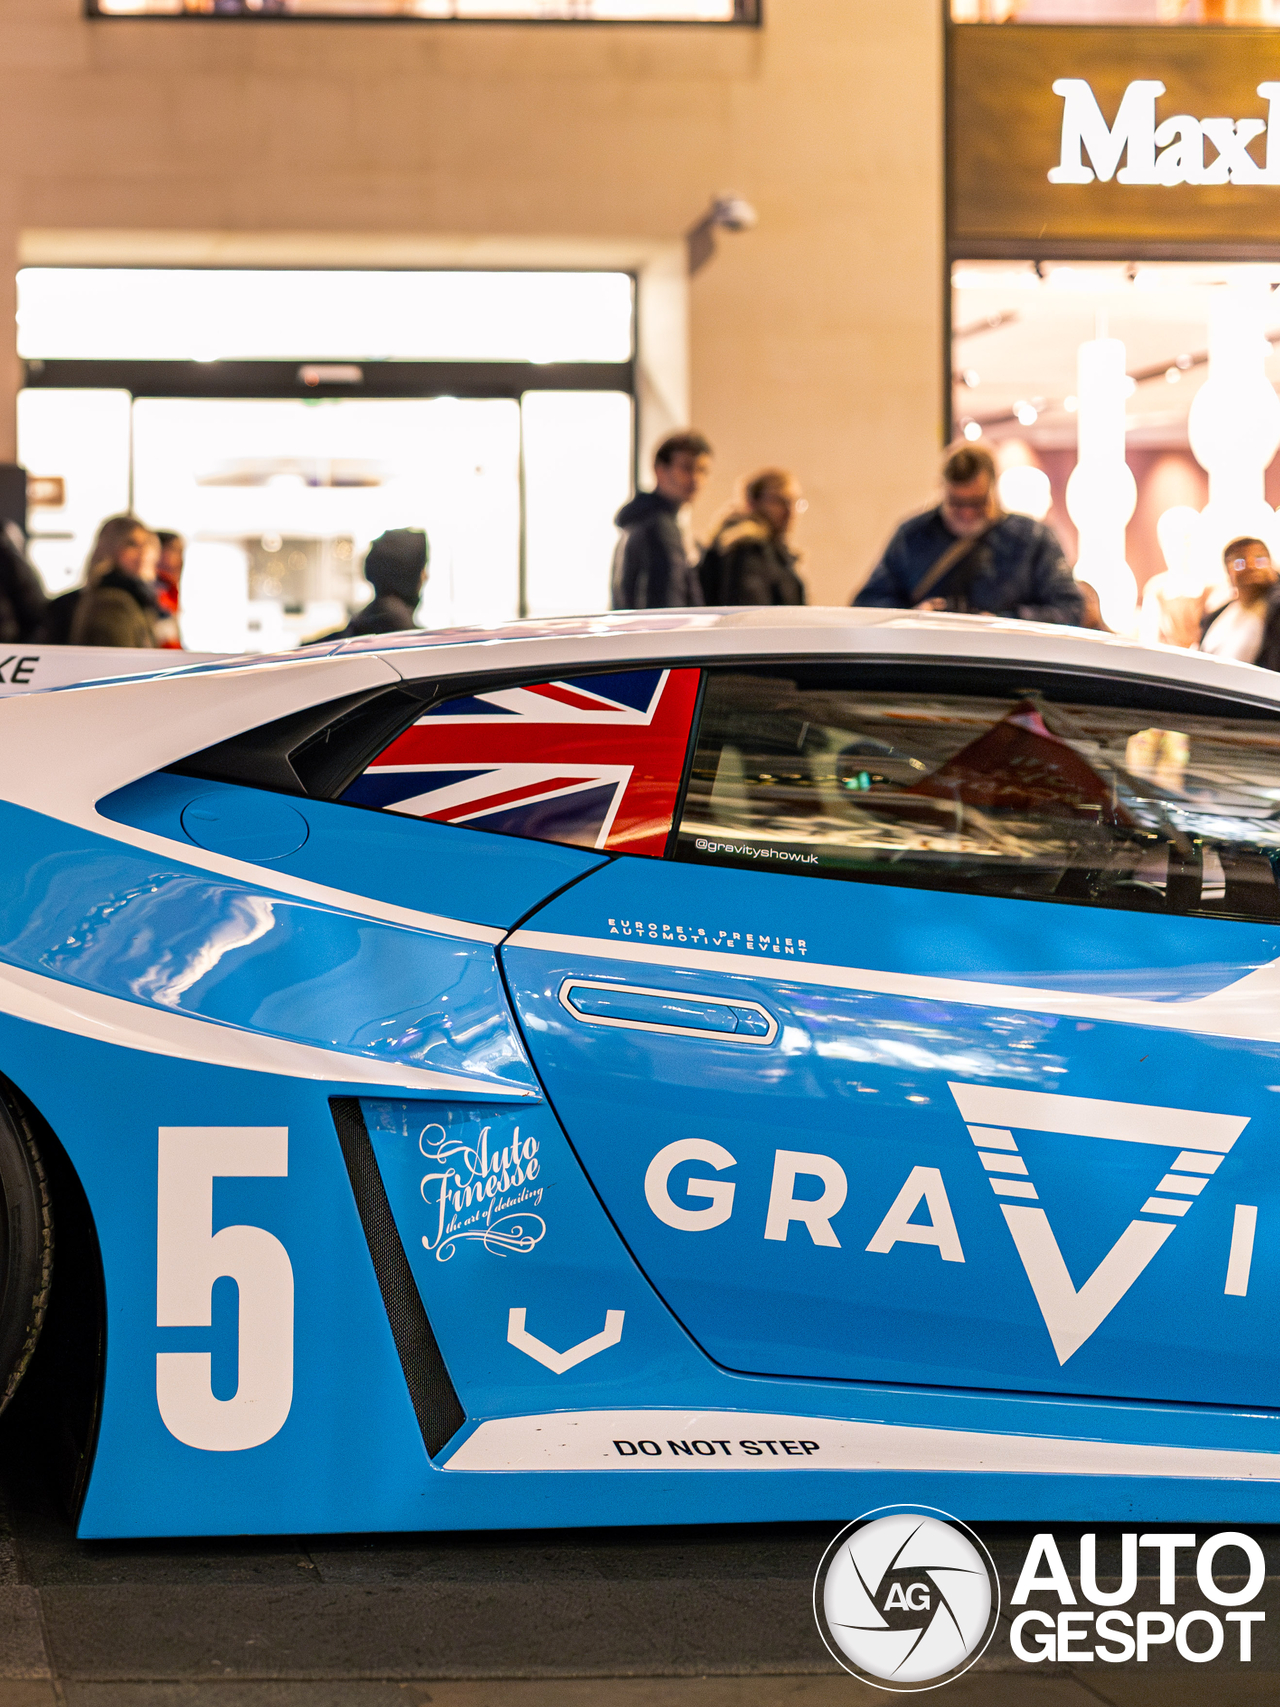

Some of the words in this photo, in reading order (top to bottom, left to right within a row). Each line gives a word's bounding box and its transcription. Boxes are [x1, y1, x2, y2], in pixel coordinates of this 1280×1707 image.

[1047, 78, 1280, 187] Max
[695, 838, 819, 865] @gravityshowuk
[608, 918, 706, 936] EUROPE'S
[719, 930, 807, 948] PREMIER
[610, 926, 735, 948] AUTOMOTIVE
[746, 941, 808, 955] EVENT
[436, 1125, 540, 1185] Auto
[421, 1158, 541, 1248] Finesse
[446, 1214, 462, 1234] the
[464, 1211, 480, 1226] art
[482, 1197, 497, 1226] of
[494, 1187, 544, 1213] detailing
[156, 1126, 294, 1451] 5
[612, 1440, 662, 1456] DO
[667, 1440, 732, 1456] NOT
[739, 1440, 820, 1456] STEP
